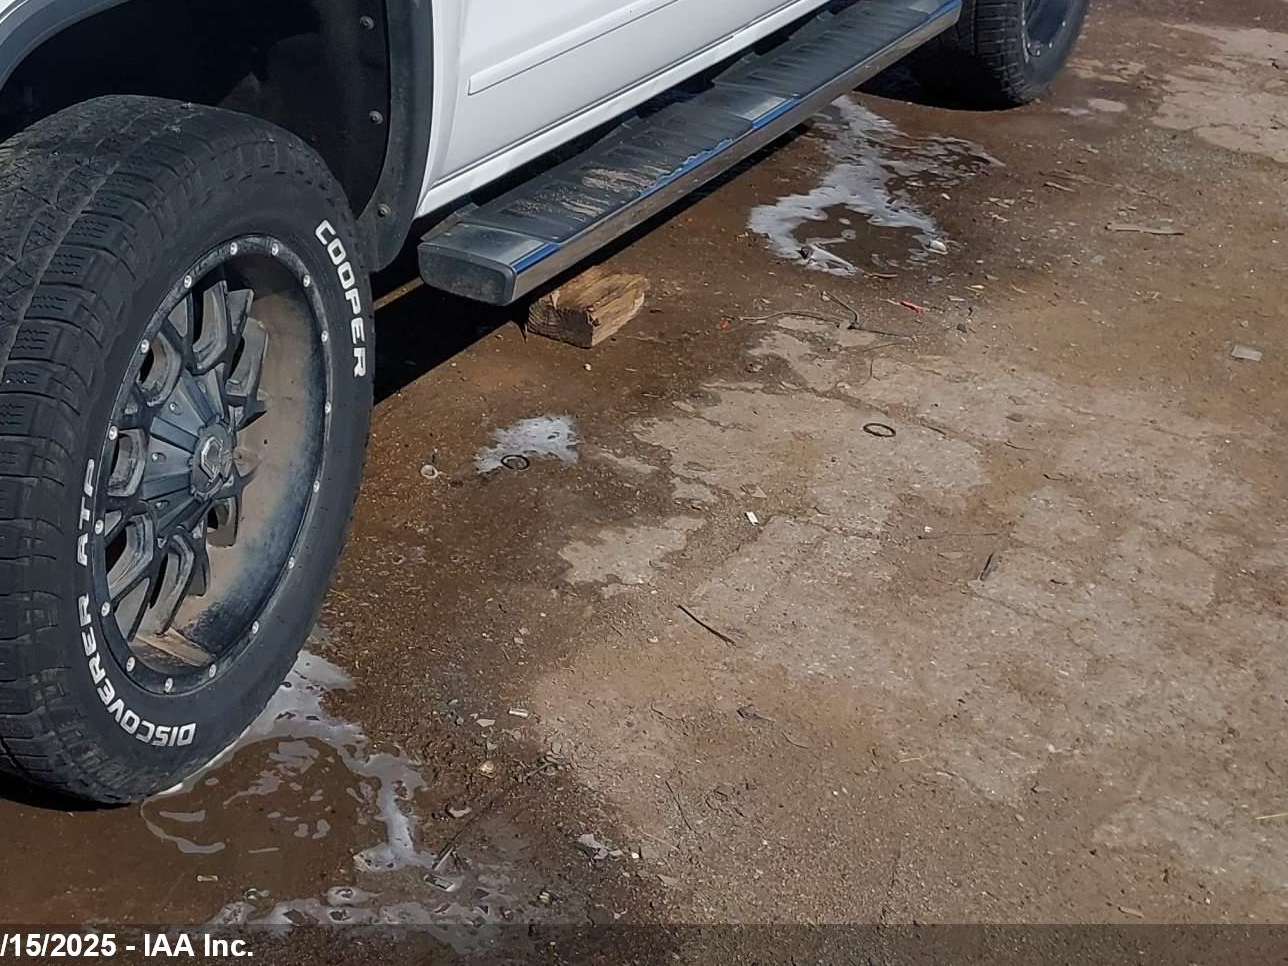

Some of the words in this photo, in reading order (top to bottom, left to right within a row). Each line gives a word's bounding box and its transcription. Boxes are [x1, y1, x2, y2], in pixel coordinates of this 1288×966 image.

[315, 219, 367, 378] COOPER
[77, 458, 95, 567] ATP
[78, 593, 197, 747] DISCOVERER
